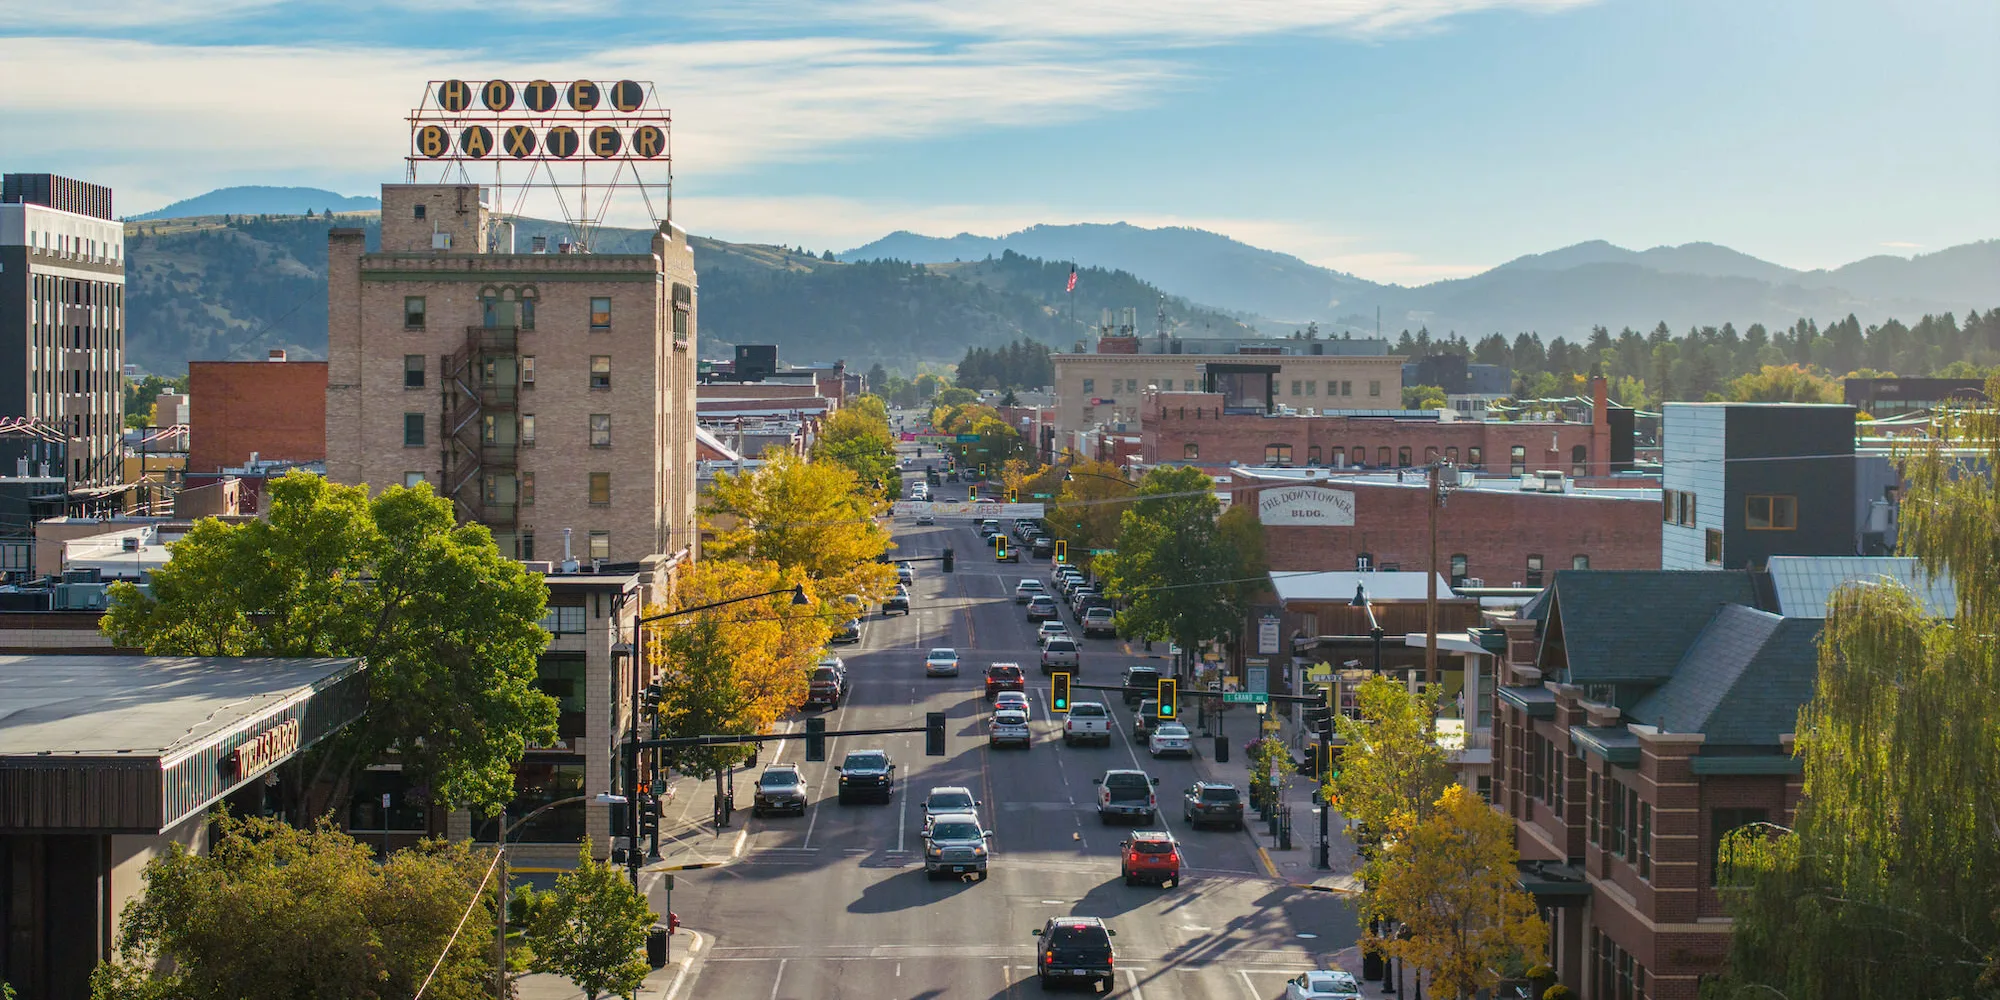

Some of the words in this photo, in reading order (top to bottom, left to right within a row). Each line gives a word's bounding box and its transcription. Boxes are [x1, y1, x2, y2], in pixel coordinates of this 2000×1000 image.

[445, 80, 637, 112] HOTEL
[423, 125, 658, 158] BAXTER
[1261, 498, 1281, 511] THE
[1281, 489, 1352, 514] DOWNTOWNER
[1291, 509, 1325, 518] BLDG.
[1234, 693, 1253, 701] GRAND
[236, 732, 270, 781] WELLS
[271, 718, 299, 762] FARGO
